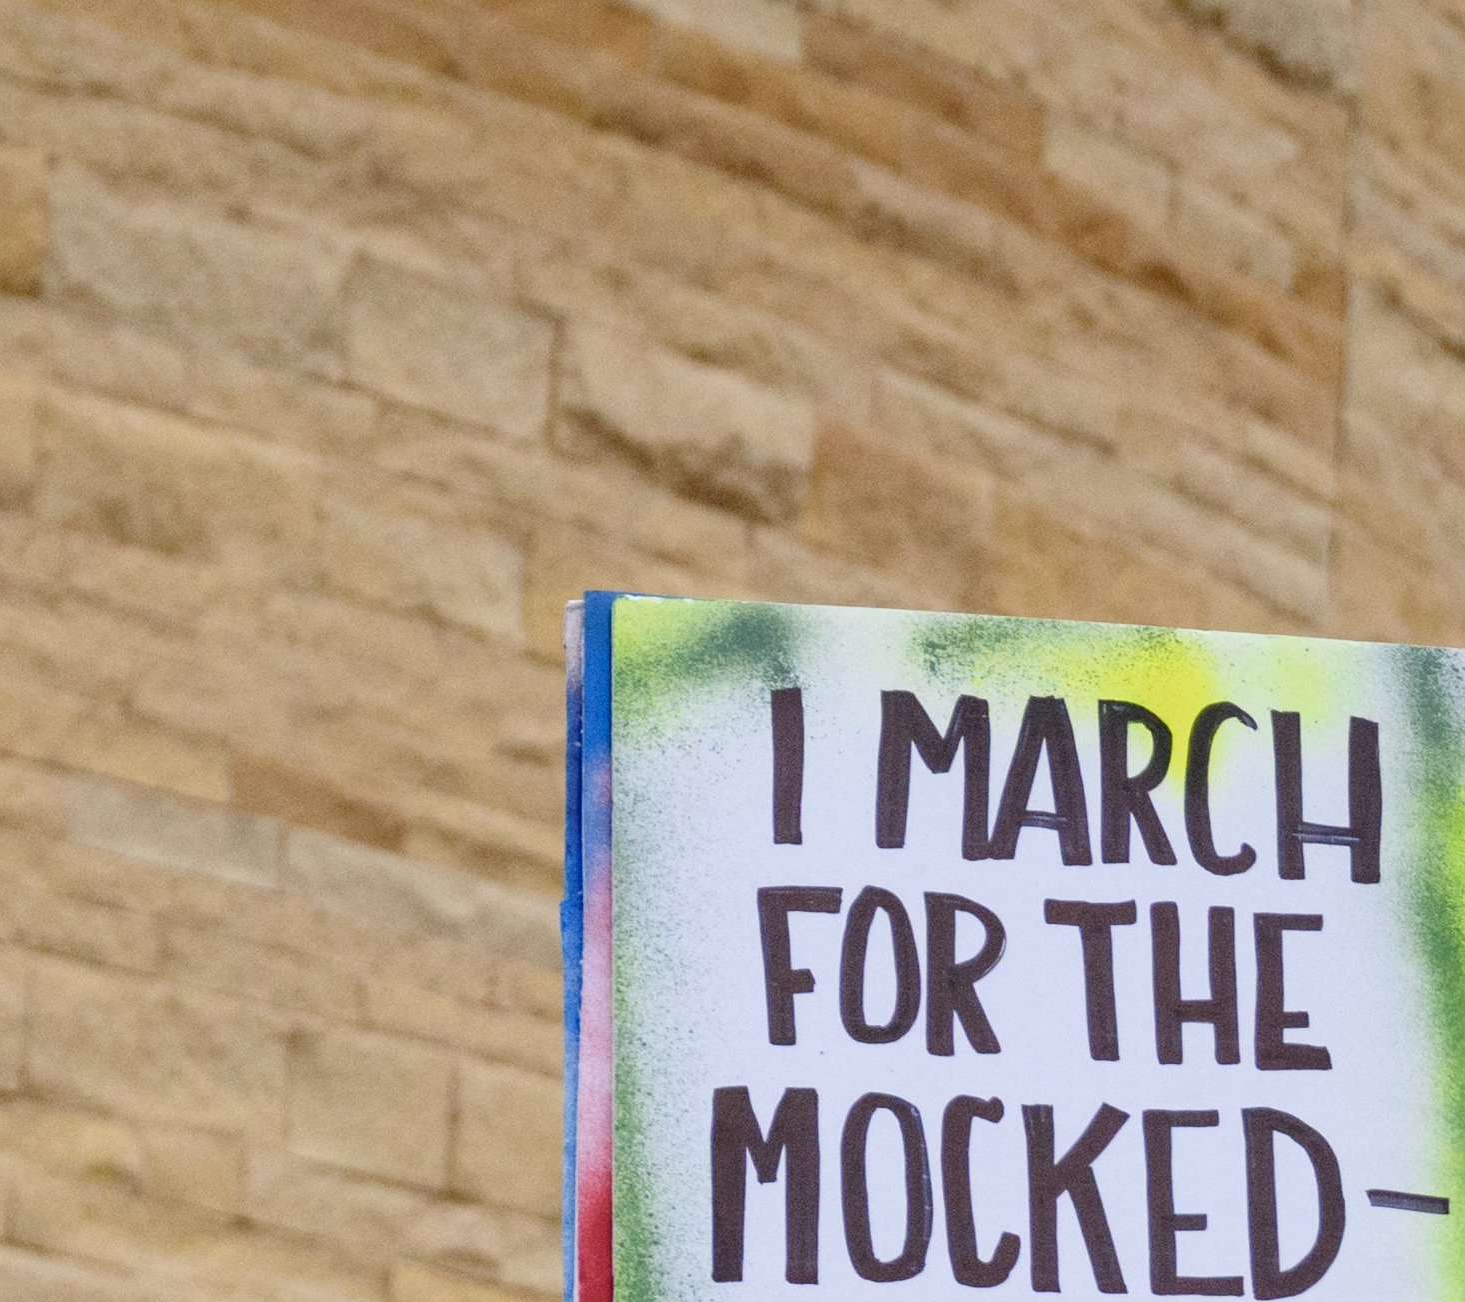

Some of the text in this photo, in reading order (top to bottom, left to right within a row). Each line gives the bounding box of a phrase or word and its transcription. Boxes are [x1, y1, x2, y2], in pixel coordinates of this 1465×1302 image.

[770, 687, 1382, 883] I MARCH
[757, 885, 1333, 1069] FOR THE
